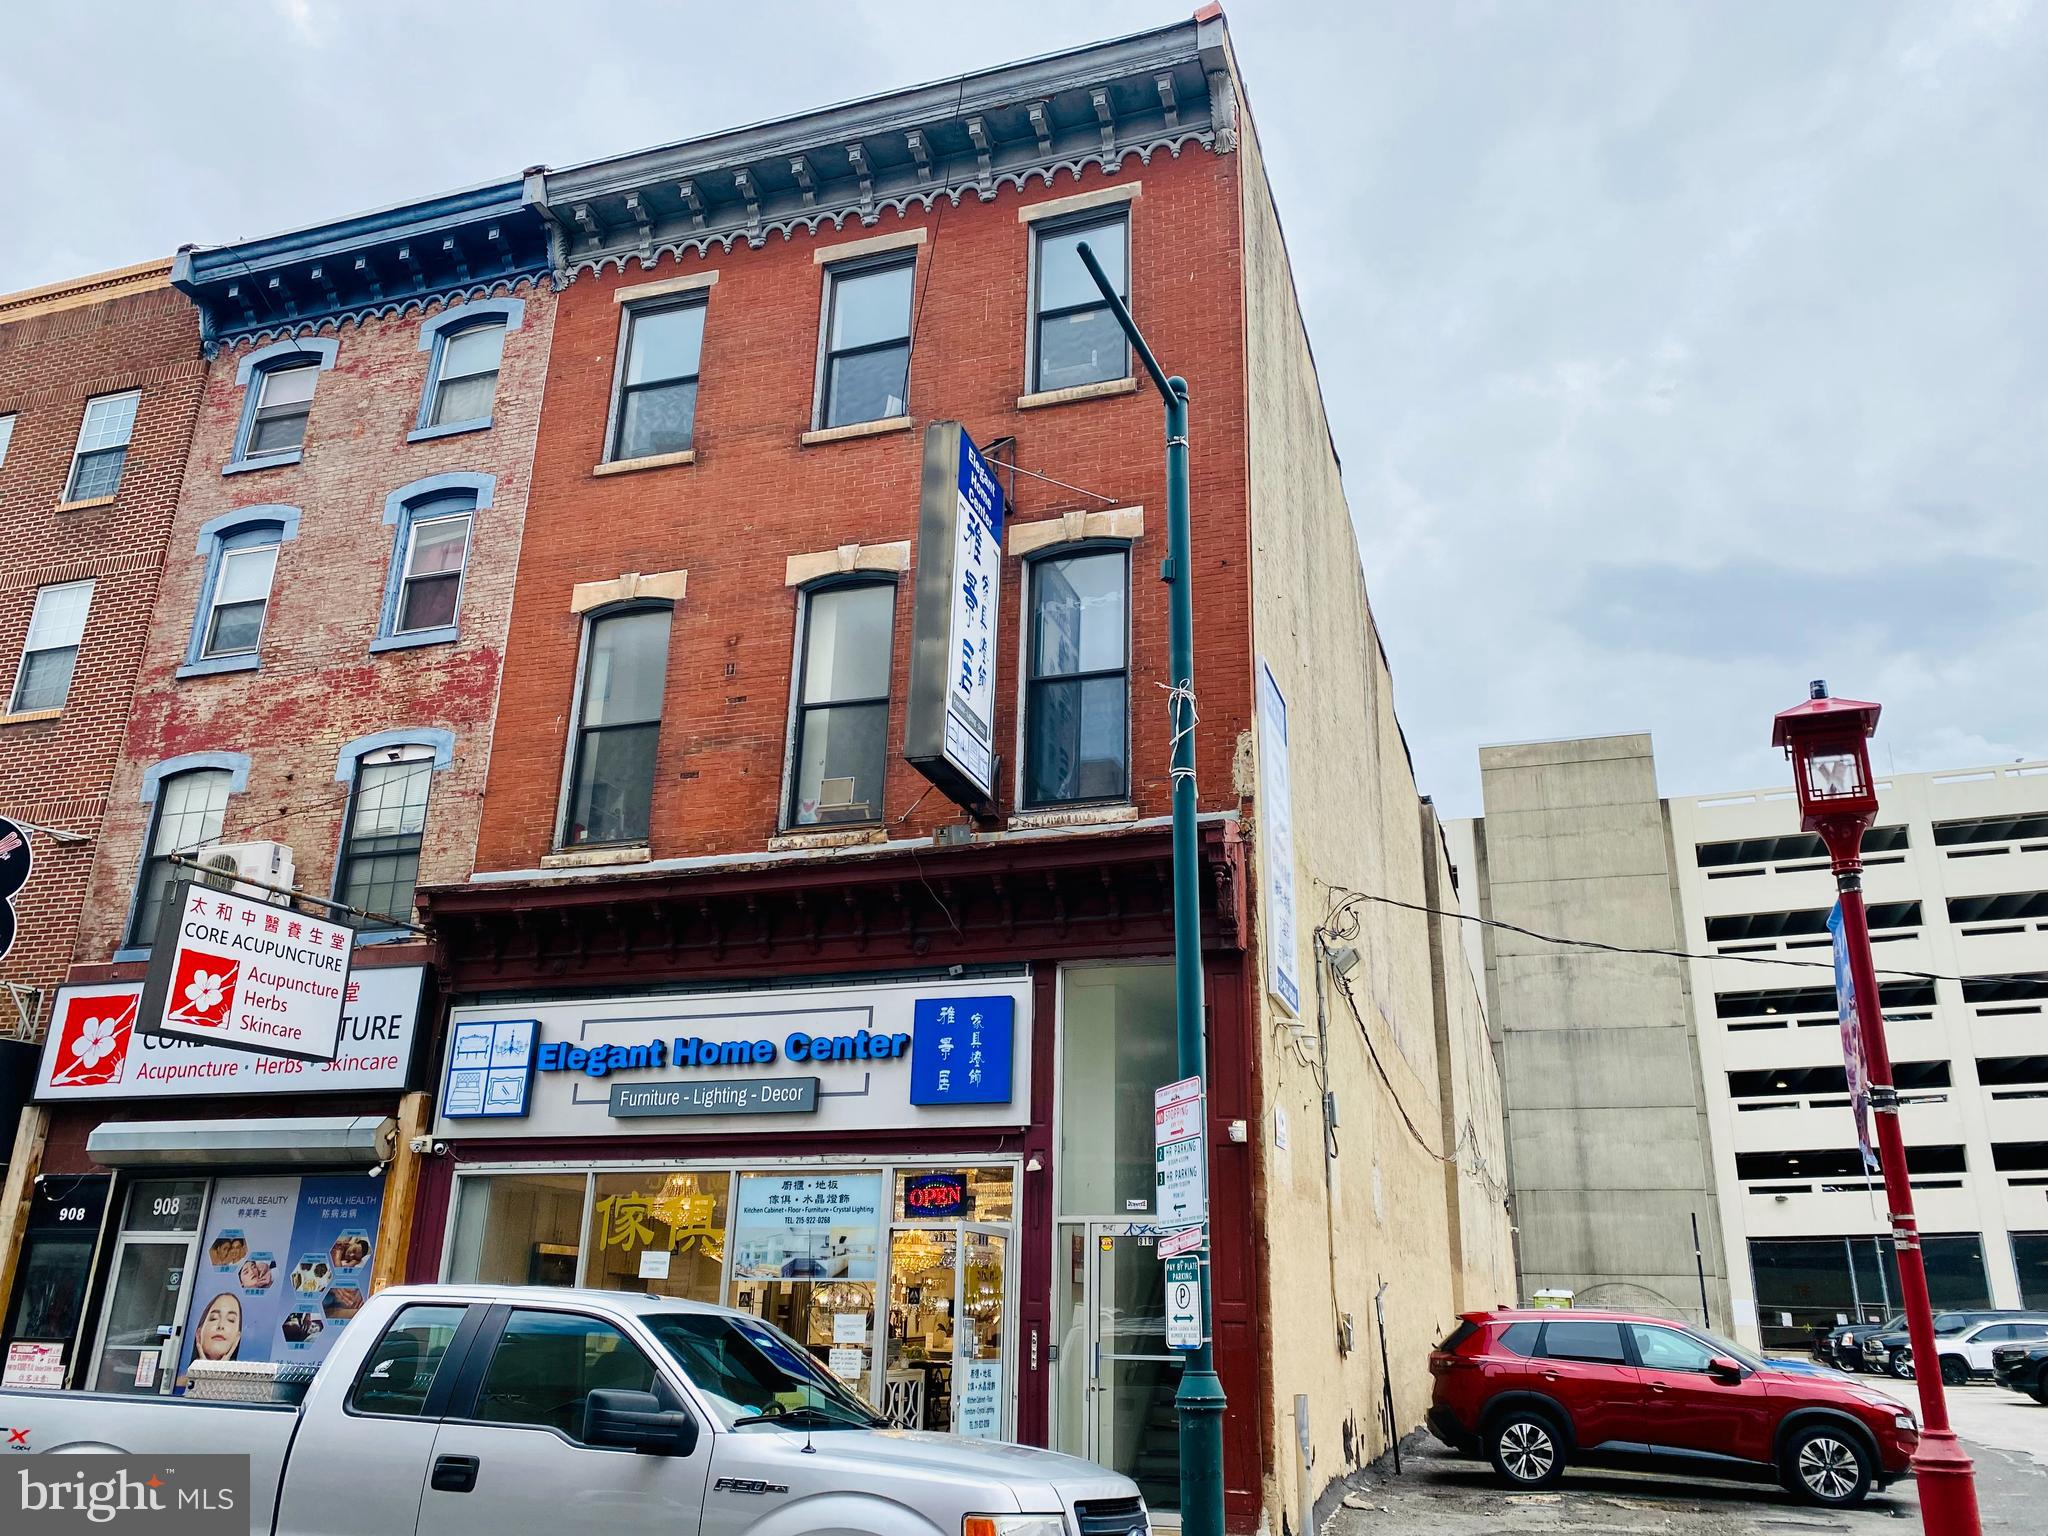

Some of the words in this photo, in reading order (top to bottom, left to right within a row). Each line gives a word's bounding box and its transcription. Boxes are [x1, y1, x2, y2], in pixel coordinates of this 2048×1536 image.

[968, 446, 996, 498] Elegant
[971, 471, 992, 508] Home
[968, 489, 993, 530] Center
[190, 897, 345, 950] 太和中醫養生堂
[185, 922, 229, 945] CORE
[231, 934, 343, 972] ACUPUNCTURE
[248, 966, 339, 999] Acupuncture
[244, 990, 288, 1013] Herbs
[240, 1015, 302, 1040] Skincare
[537, 1038, 667, 1078] Elegant
[672, 1036, 776, 1066] Home
[785, 1029, 911, 1063] Center
[137, 1060, 238, 1083] Acupuncture
[255, 1057, 303, 1075] Herbs
[321, 1054, 398, 1072] Skincare
[620, 1089, 680, 1108] Furniture
[693, 1086, 748, 1108] Lighting
[761, 1085, 803, 1103] Decor
[1165, 1105, 1189, 1121] STOPPING
[1166, 1146, 1172, 1157] HR
[1174, 1141, 1196, 1155] PARKING
[1167, 1171, 1173, 1182] HR
[1175, 1166, 1197, 1180] PARKING
[153, 1198, 179, 1215] 908
[221, 1196, 255, 1205] NATURAL
[257, 1196, 289, 1205] BEAUTY
[308, 1196, 343, 1205] NATURAL
[344, 1196, 377, 1205] HEALTH
[909, 1186, 961, 1207] OPEN
[59, 1208, 85, 1221] 908
[833, 1206, 851, 1214] Crystal
[852, 1205, 875, 1214] Lighting
[1167, 1263, 1175, 1272] PAY
[1177, 1263, 1184, 1271] BY
[1185, 1262, 1198, 1271] PLATE
[1172, 1272, 1193, 1281] PARKING
